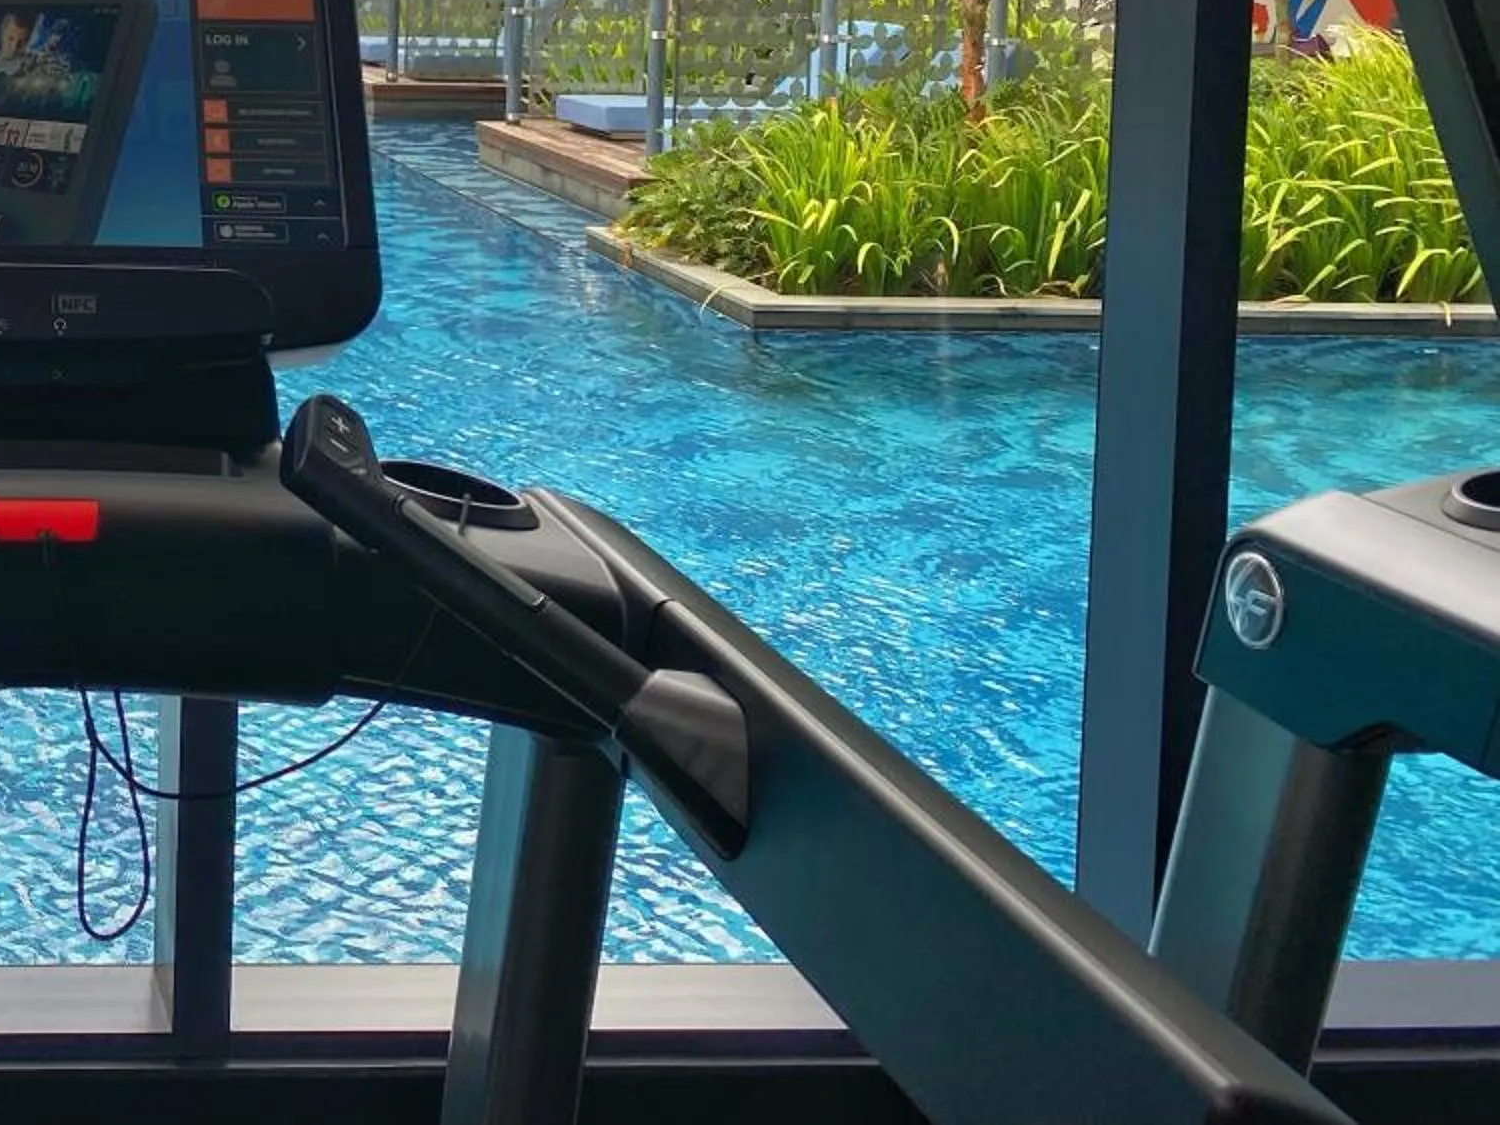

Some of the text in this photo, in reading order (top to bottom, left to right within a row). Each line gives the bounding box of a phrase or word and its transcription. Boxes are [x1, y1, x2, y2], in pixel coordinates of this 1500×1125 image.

[204, 33, 250, 46] LOG IN
[61, 297, 95, 312] NFC
